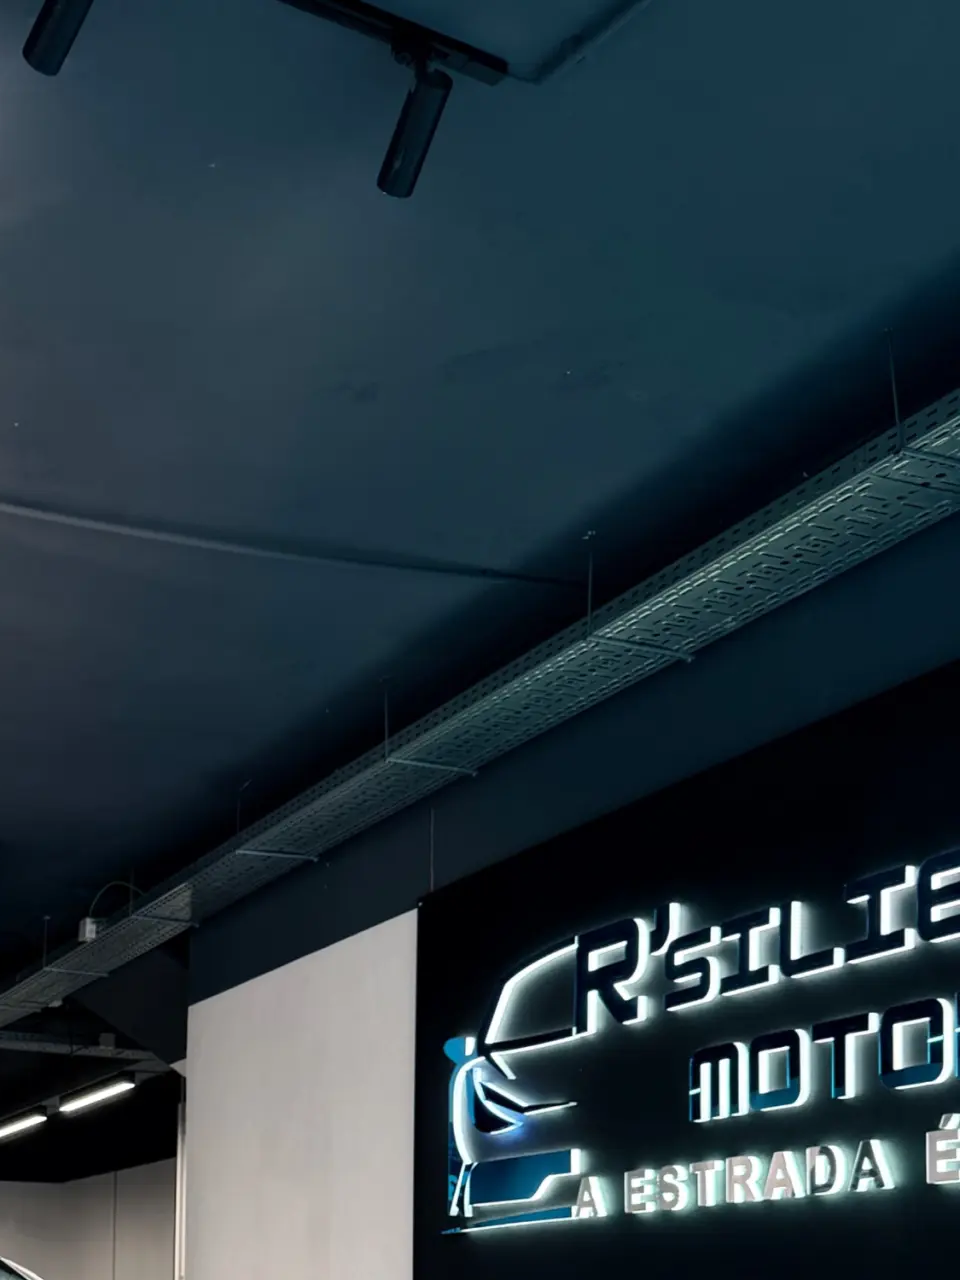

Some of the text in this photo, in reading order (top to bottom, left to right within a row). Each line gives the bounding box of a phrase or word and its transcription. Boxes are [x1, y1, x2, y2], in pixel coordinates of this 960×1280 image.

[688, 992, 960, 1123] MOTO
[575, 1175, 607, 1218] A
[624, 1138, 895, 1215] ESTRADA
